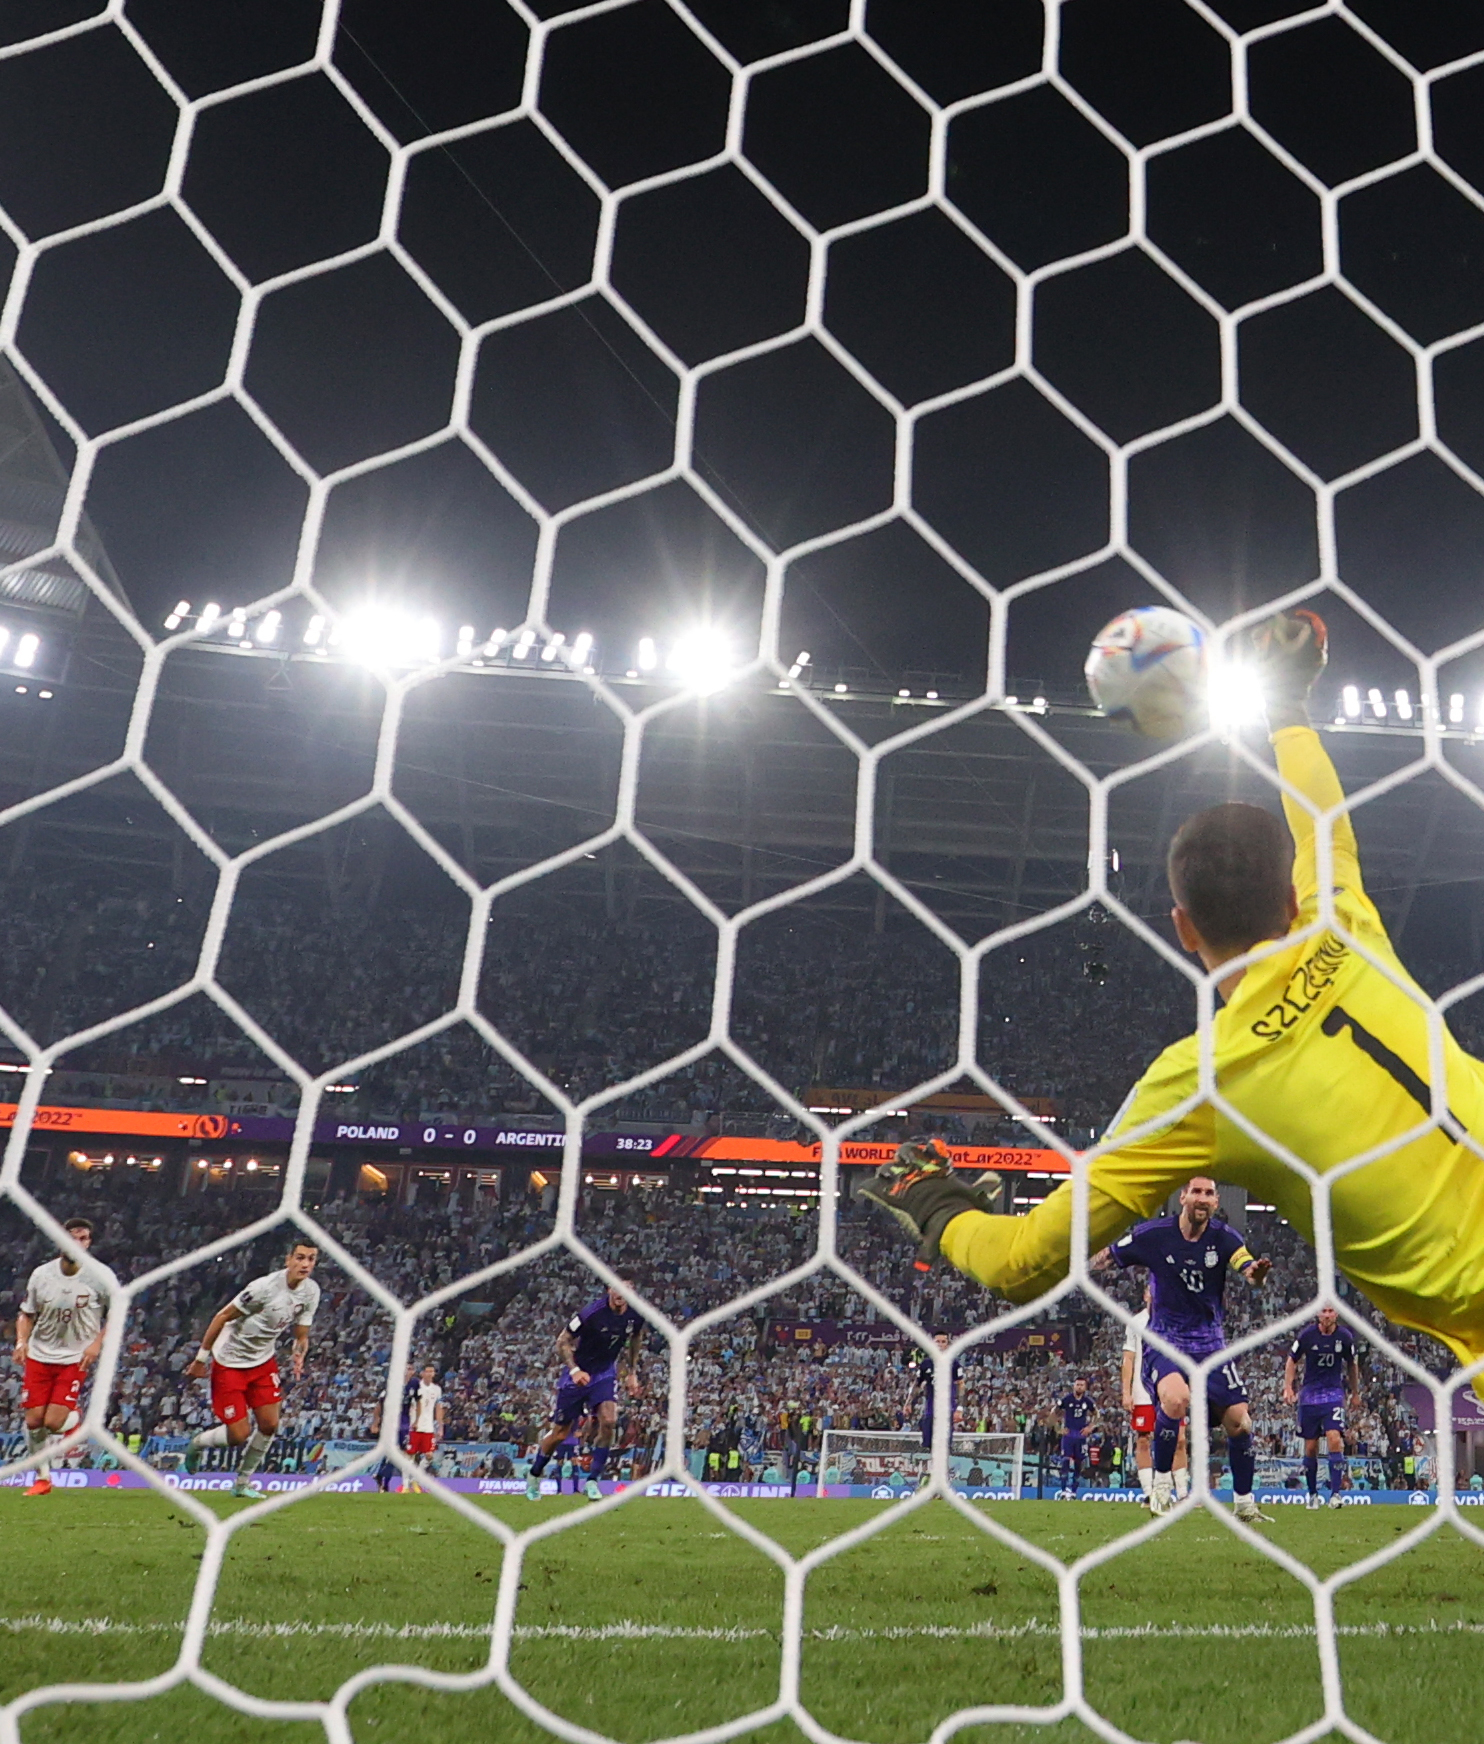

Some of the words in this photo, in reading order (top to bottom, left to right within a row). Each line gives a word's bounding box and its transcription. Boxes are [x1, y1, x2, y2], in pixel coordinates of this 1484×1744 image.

[1321, 1005, 1467, 1146] 1
[337, 1125, 398, 1140] POLAND
[423, 1128, 436, 1143] 0
[463, 1129, 476, 1145] 0
[616, 1138, 653, 1151] 38:23
[1179, 1268, 1204, 1293] 10
[57, 1308, 72, 1324] 18
[608, 1335, 620, 1350] 7
[1317, 1353, 1335, 1368] 20
[164, 1474, 233, 1491] Dance
[479, 1481, 502, 1490] FIFA
